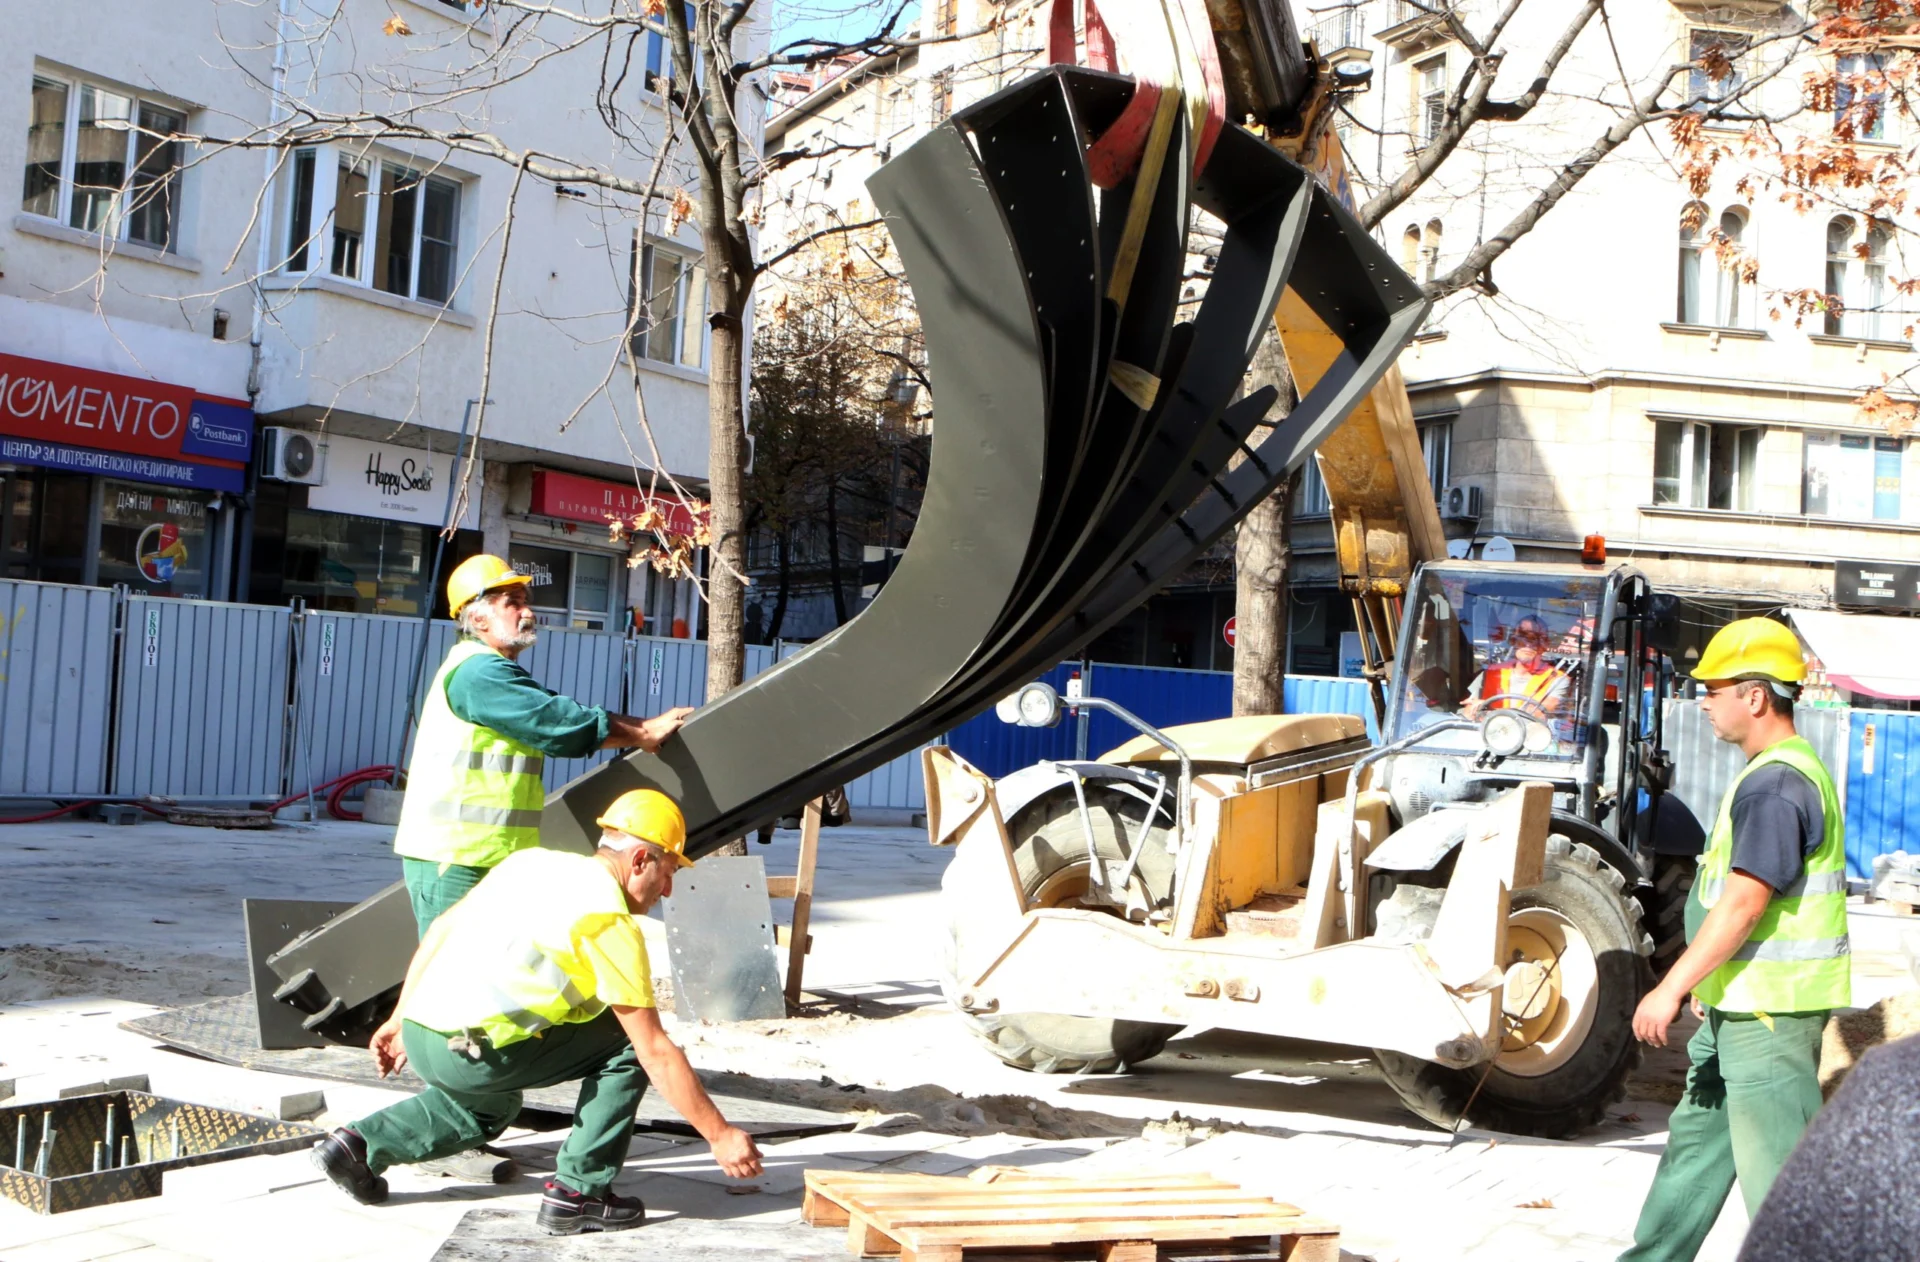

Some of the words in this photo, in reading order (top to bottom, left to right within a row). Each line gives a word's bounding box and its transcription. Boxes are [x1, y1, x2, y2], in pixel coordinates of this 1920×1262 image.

[0, 373, 180, 440] OMENTO
[204, 427, 243, 442] Postbank
[2, 439, 42, 460] ЦЕНТЪР
[43, 447, 56, 461] ЗА
[57, 448, 133, 472] ПОТРЕБИТЕЛСКО
[132, 459, 195, 481] КРЕДИТИРАНЕ
[365, 452, 400, 495] Happy
[603, 489, 667, 516] ПАРЖ
